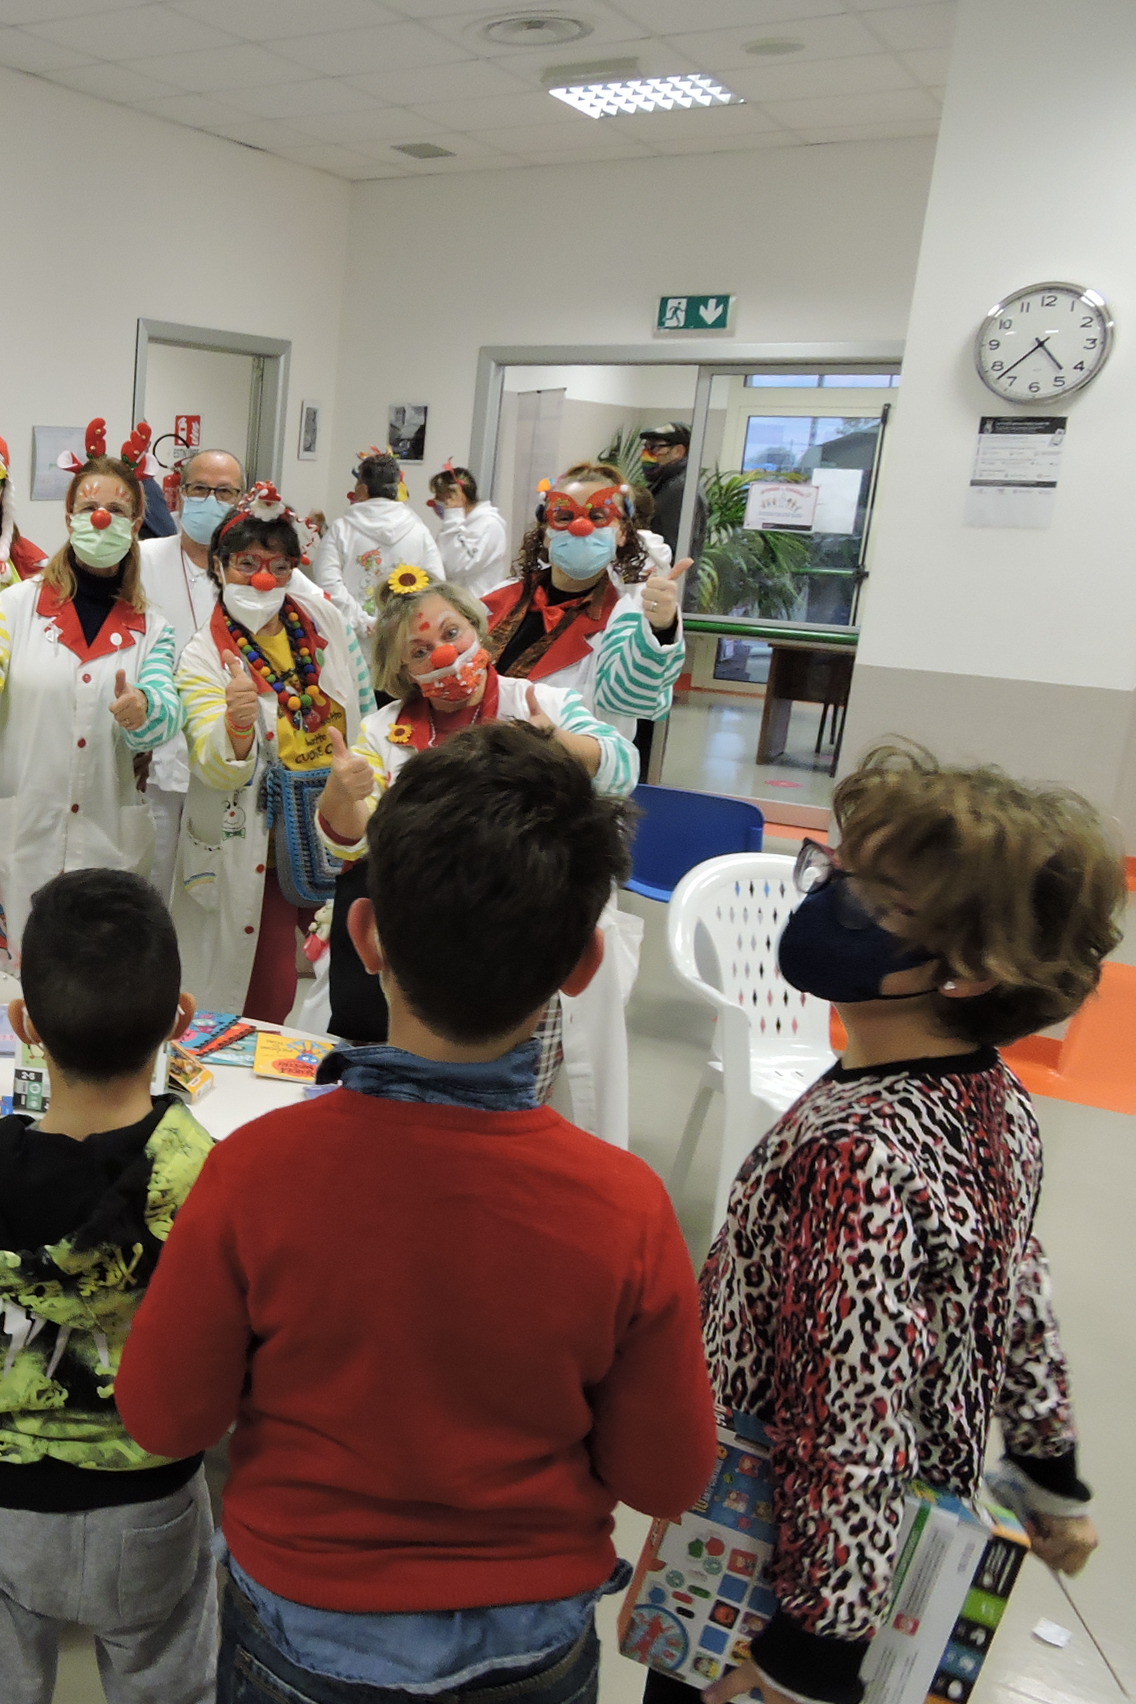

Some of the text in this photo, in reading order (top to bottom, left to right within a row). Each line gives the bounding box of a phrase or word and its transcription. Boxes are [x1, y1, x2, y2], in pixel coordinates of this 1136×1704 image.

[1041, 295, 1058, 307] 12
[1020, 302, 1030, 313] 11
[999, 319, 1012, 330] 10
[1080, 316, 1093, 328] 2
[989, 339, 1000, 350] 9
[1083, 338, 1098, 350] 3
[991, 361, 1004, 371] 8
[1073, 360, 1085, 371] 4
[1006, 376, 1017, 387] 7
[1053, 376, 1065, 387] 5
[1028, 382, 1040, 393] 6
[295, 745, 323, 764] CUORE
